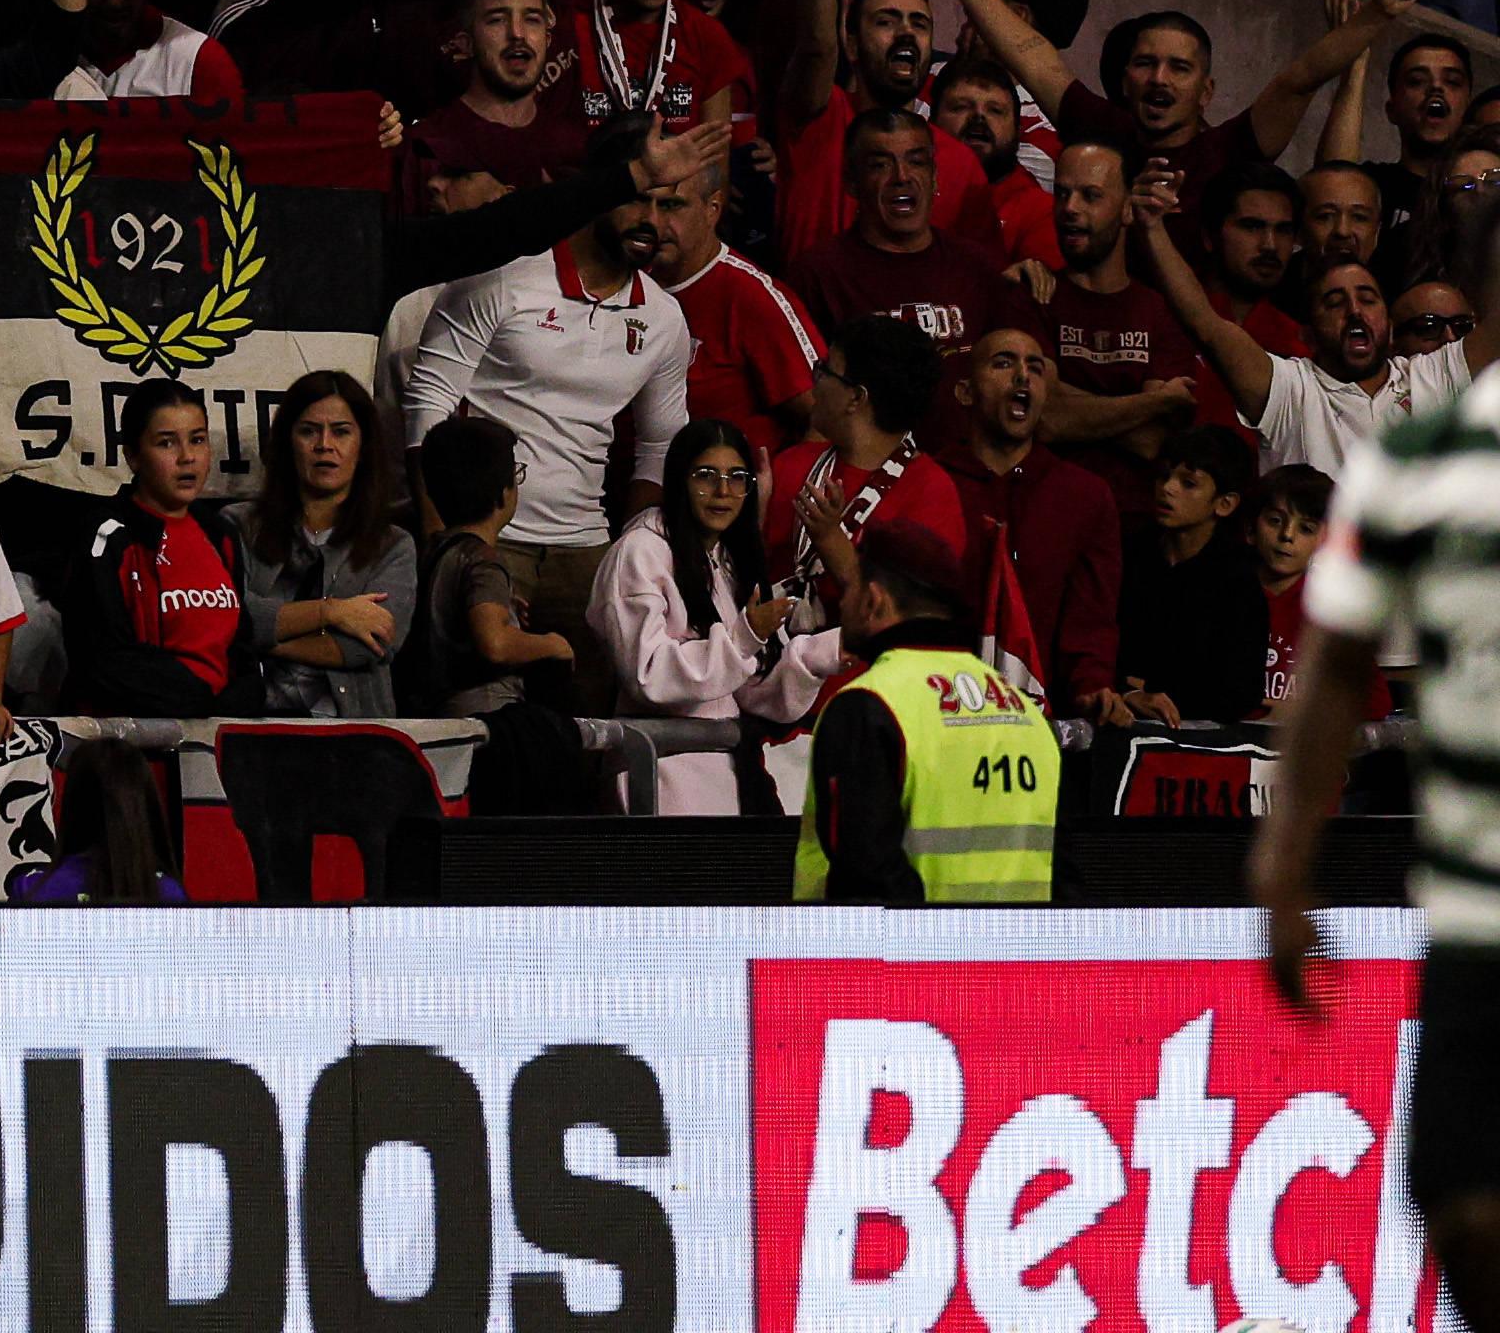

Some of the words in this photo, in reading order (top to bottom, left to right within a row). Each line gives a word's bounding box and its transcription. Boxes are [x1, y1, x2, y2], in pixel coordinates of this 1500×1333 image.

[78, 210, 214, 279] 1921
[1119, 329, 1149, 349] 1921
[972, 755, 1037, 796] 410
